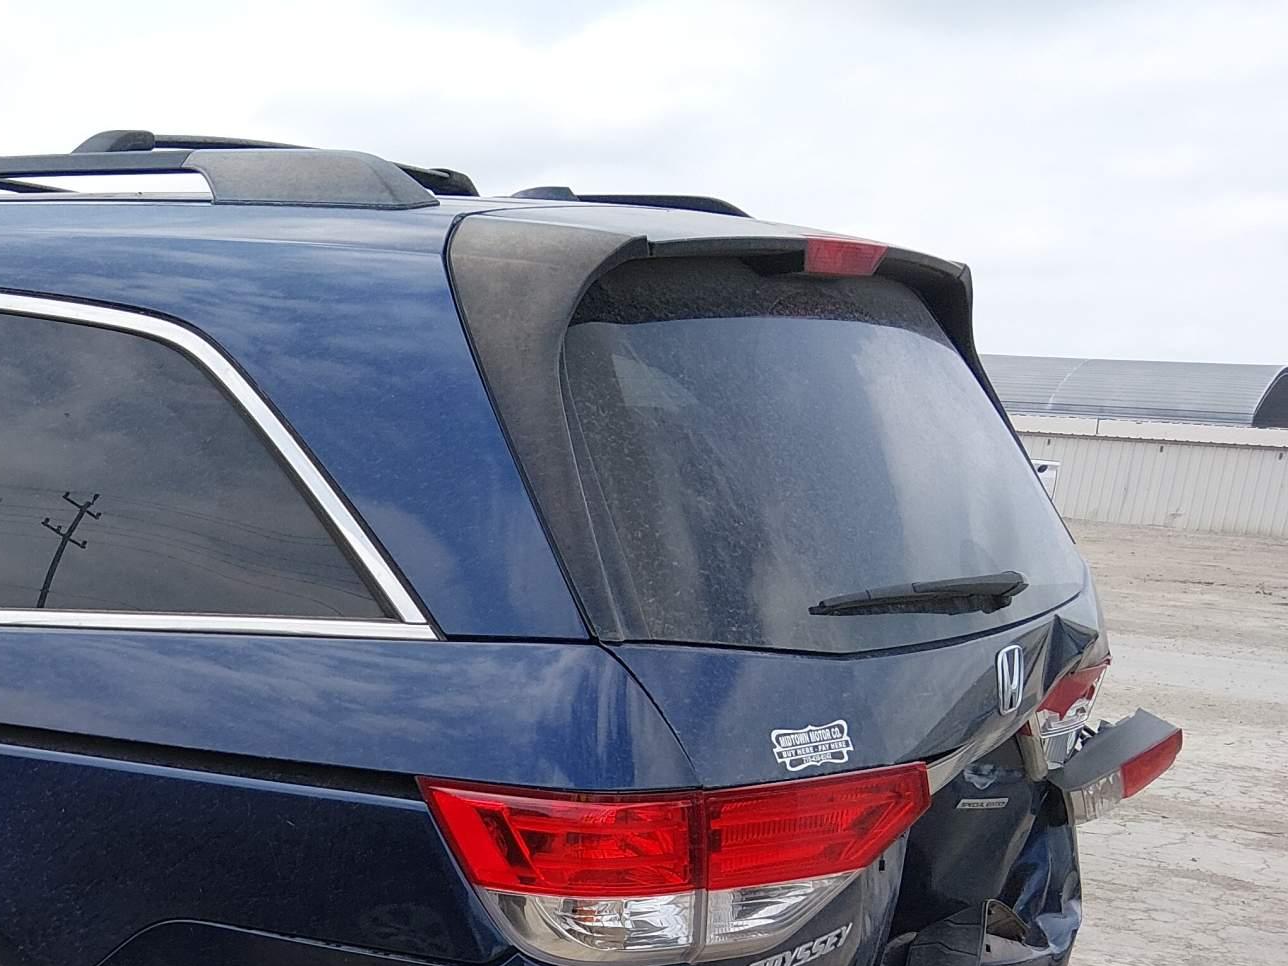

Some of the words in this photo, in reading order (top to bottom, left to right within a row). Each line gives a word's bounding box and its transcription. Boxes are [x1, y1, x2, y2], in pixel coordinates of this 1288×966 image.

[778, 732, 810, 747] MIDTOWN
[809, 728, 832, 743] MOTOR
[782, 749, 796, 758] BUY
[797, 746, 814, 755] HERE
[818, 743, 830, 752] PAY
[830, 741, 847, 749] HERE
